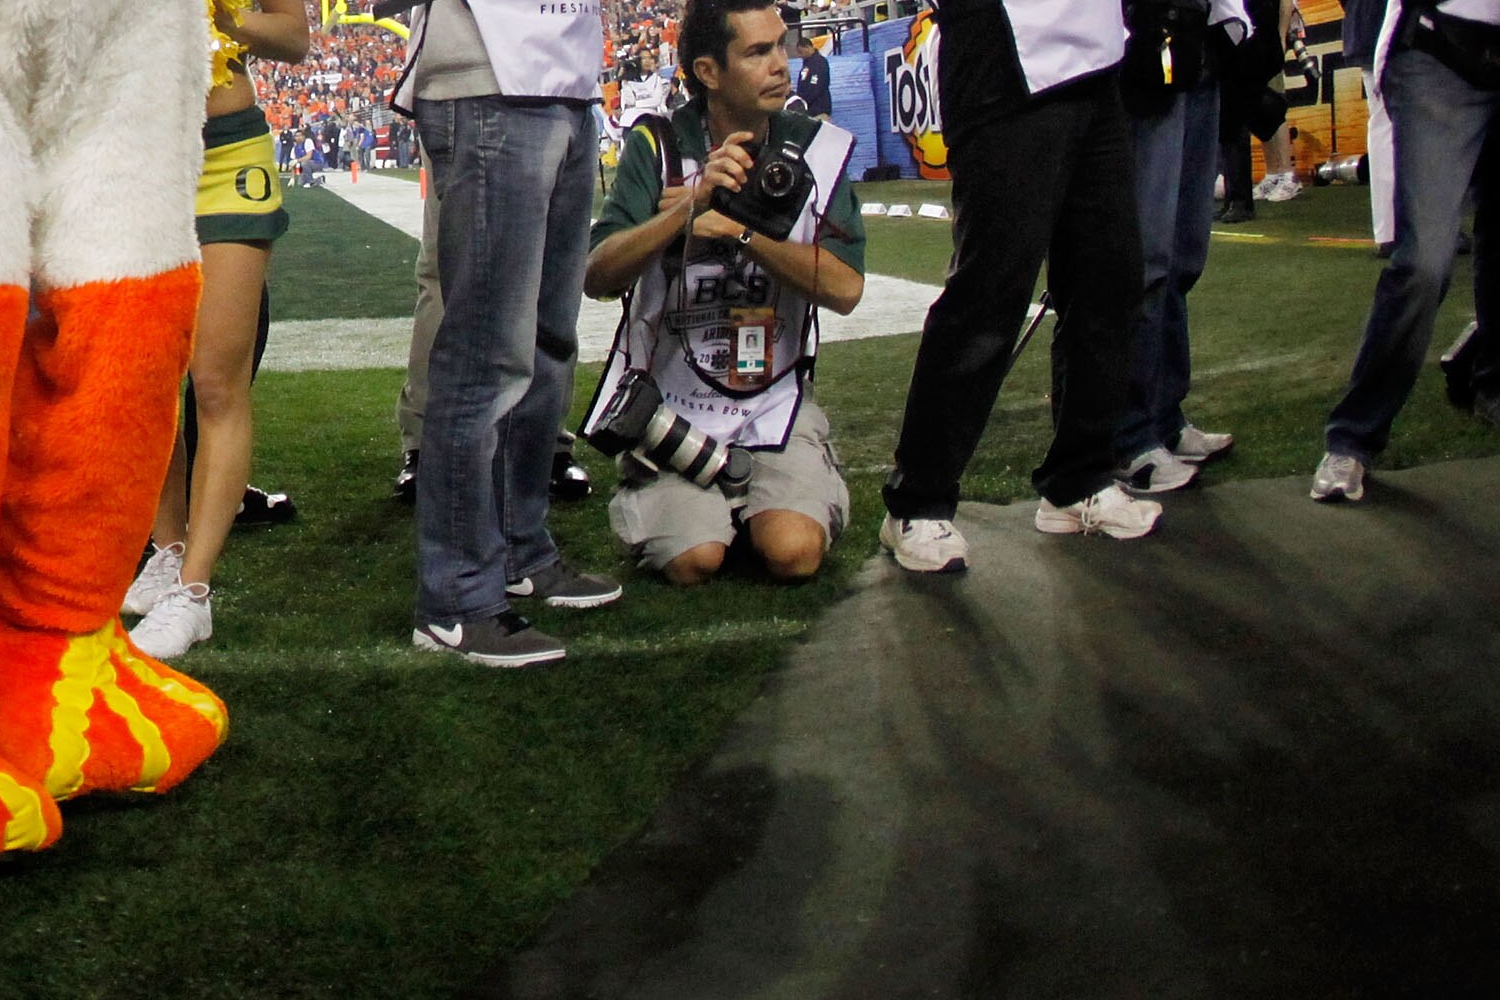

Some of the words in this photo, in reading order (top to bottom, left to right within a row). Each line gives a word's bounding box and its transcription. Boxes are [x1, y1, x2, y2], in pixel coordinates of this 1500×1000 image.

[540, 2, 589, 15] FIESTA
[235, 166, 272, 201] O
[666, 392, 715, 412] FIESTA
